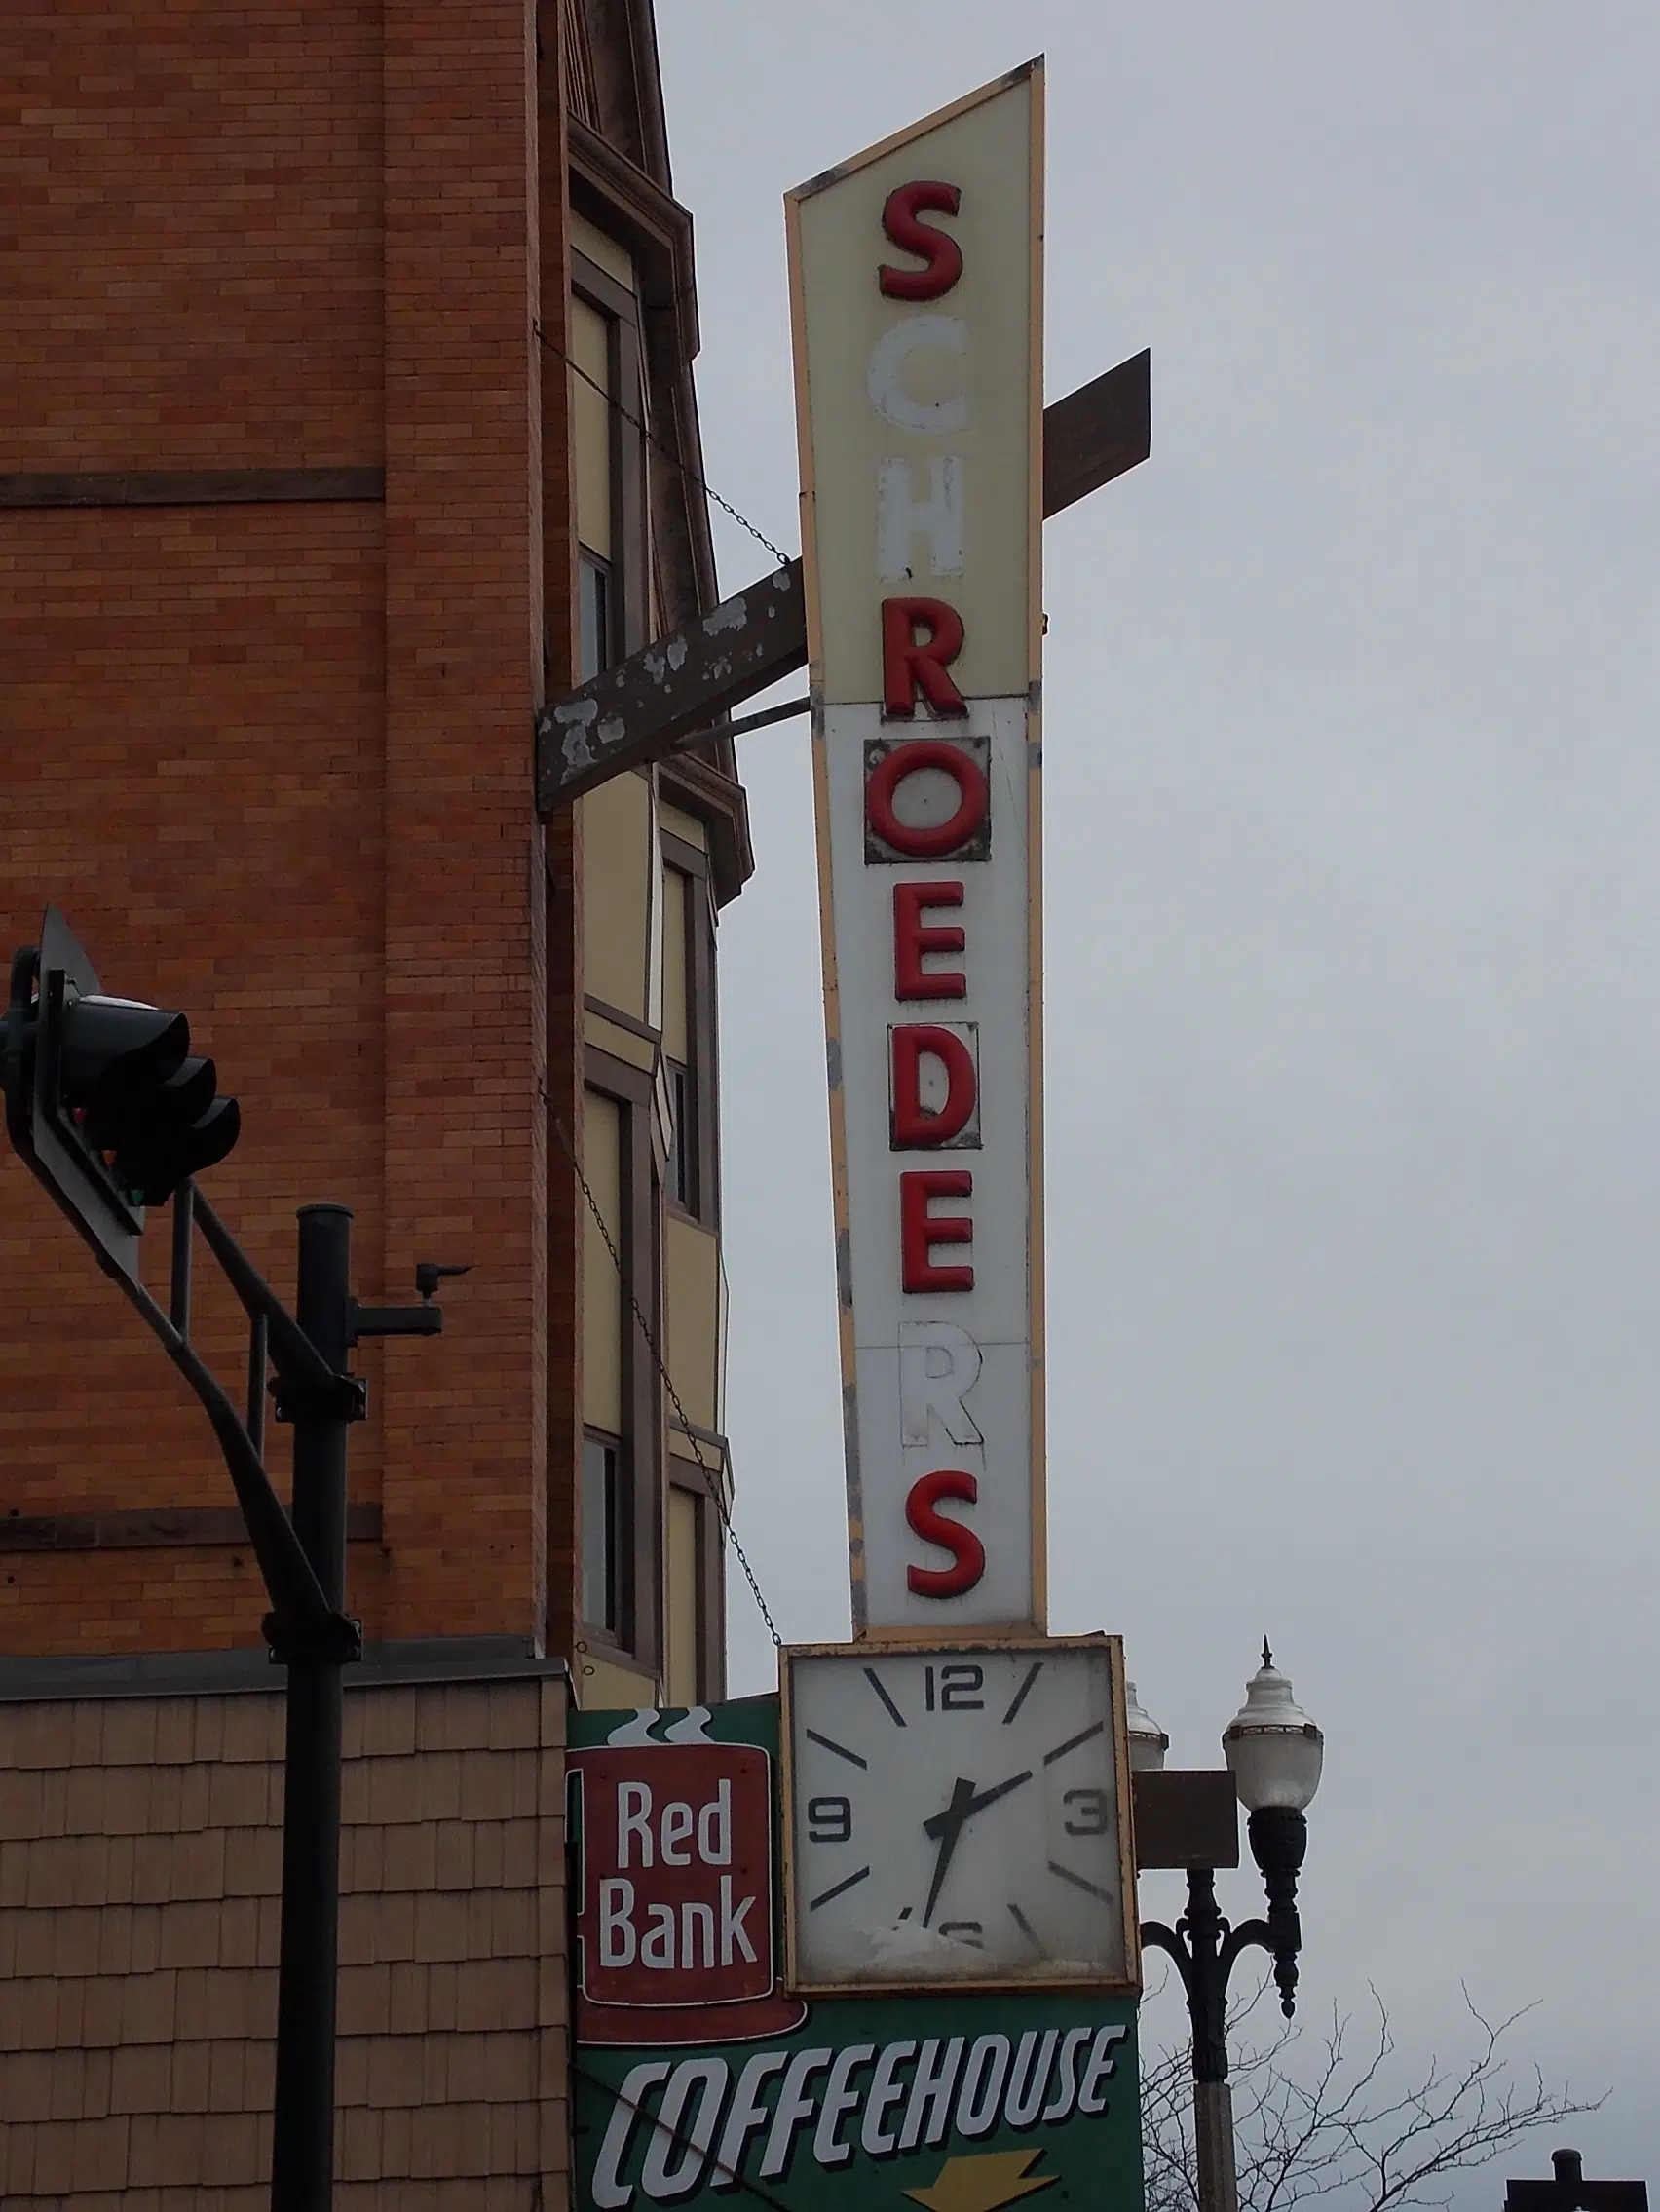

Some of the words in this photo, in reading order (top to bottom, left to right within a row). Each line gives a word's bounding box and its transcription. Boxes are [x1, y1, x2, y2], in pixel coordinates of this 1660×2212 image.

[865, 179, 990, 1599] SCHROEDERS
[925, 1664, 984, 1712] 12
[617, 1778, 731, 1869] Red
[808, 1796, 851, 1843] 9
[1063, 1789, 1108, 1836] 3
[599, 1875, 758, 1969] Bank
[591, 2024, 1127, 2209] COFFEEHOUSE
